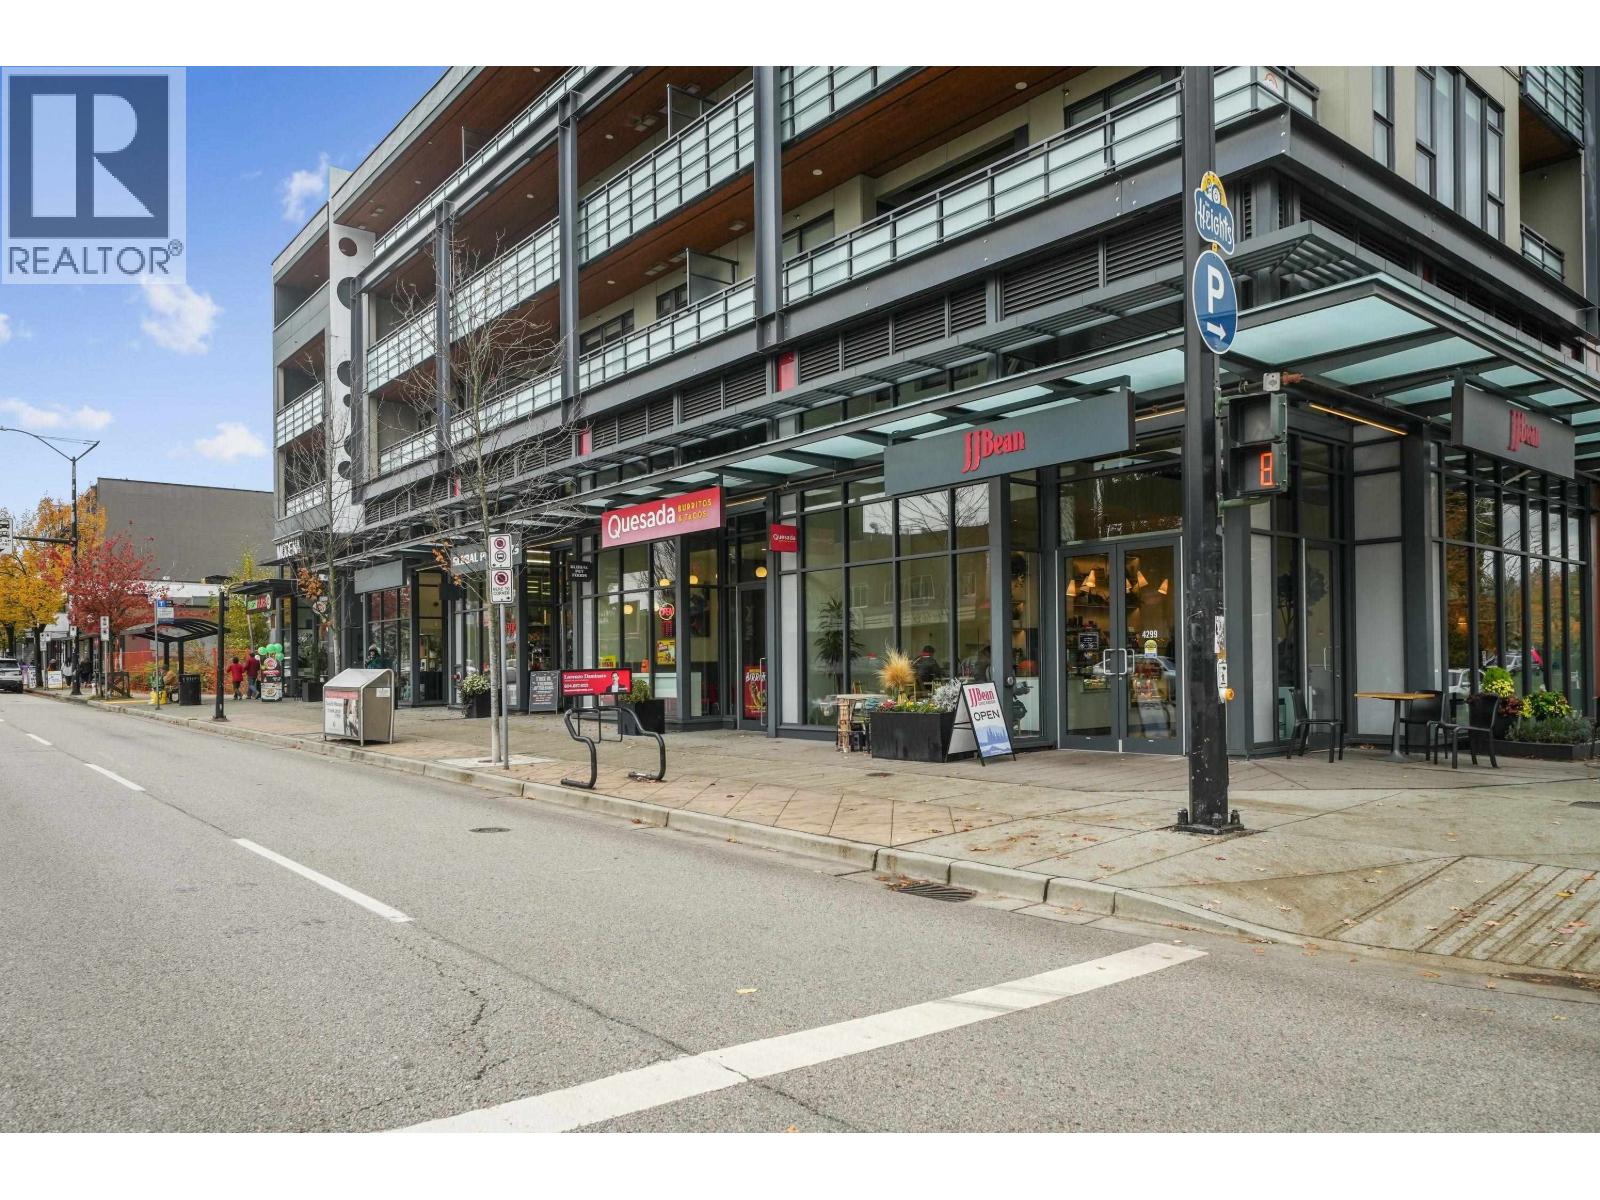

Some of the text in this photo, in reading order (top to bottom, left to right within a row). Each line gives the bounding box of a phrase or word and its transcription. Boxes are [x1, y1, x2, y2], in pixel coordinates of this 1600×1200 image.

[1198, 197, 1233, 245] Heights
[1207, 264, 1225, 314] P
[678, 499, 712, 513] BURRITOS
[607, 503, 676, 539] Quesada
[772, 533, 796, 541] Quesada
[1141, 629, 1158, 639] 4299
[973, 709, 1000, 721] OPEN
